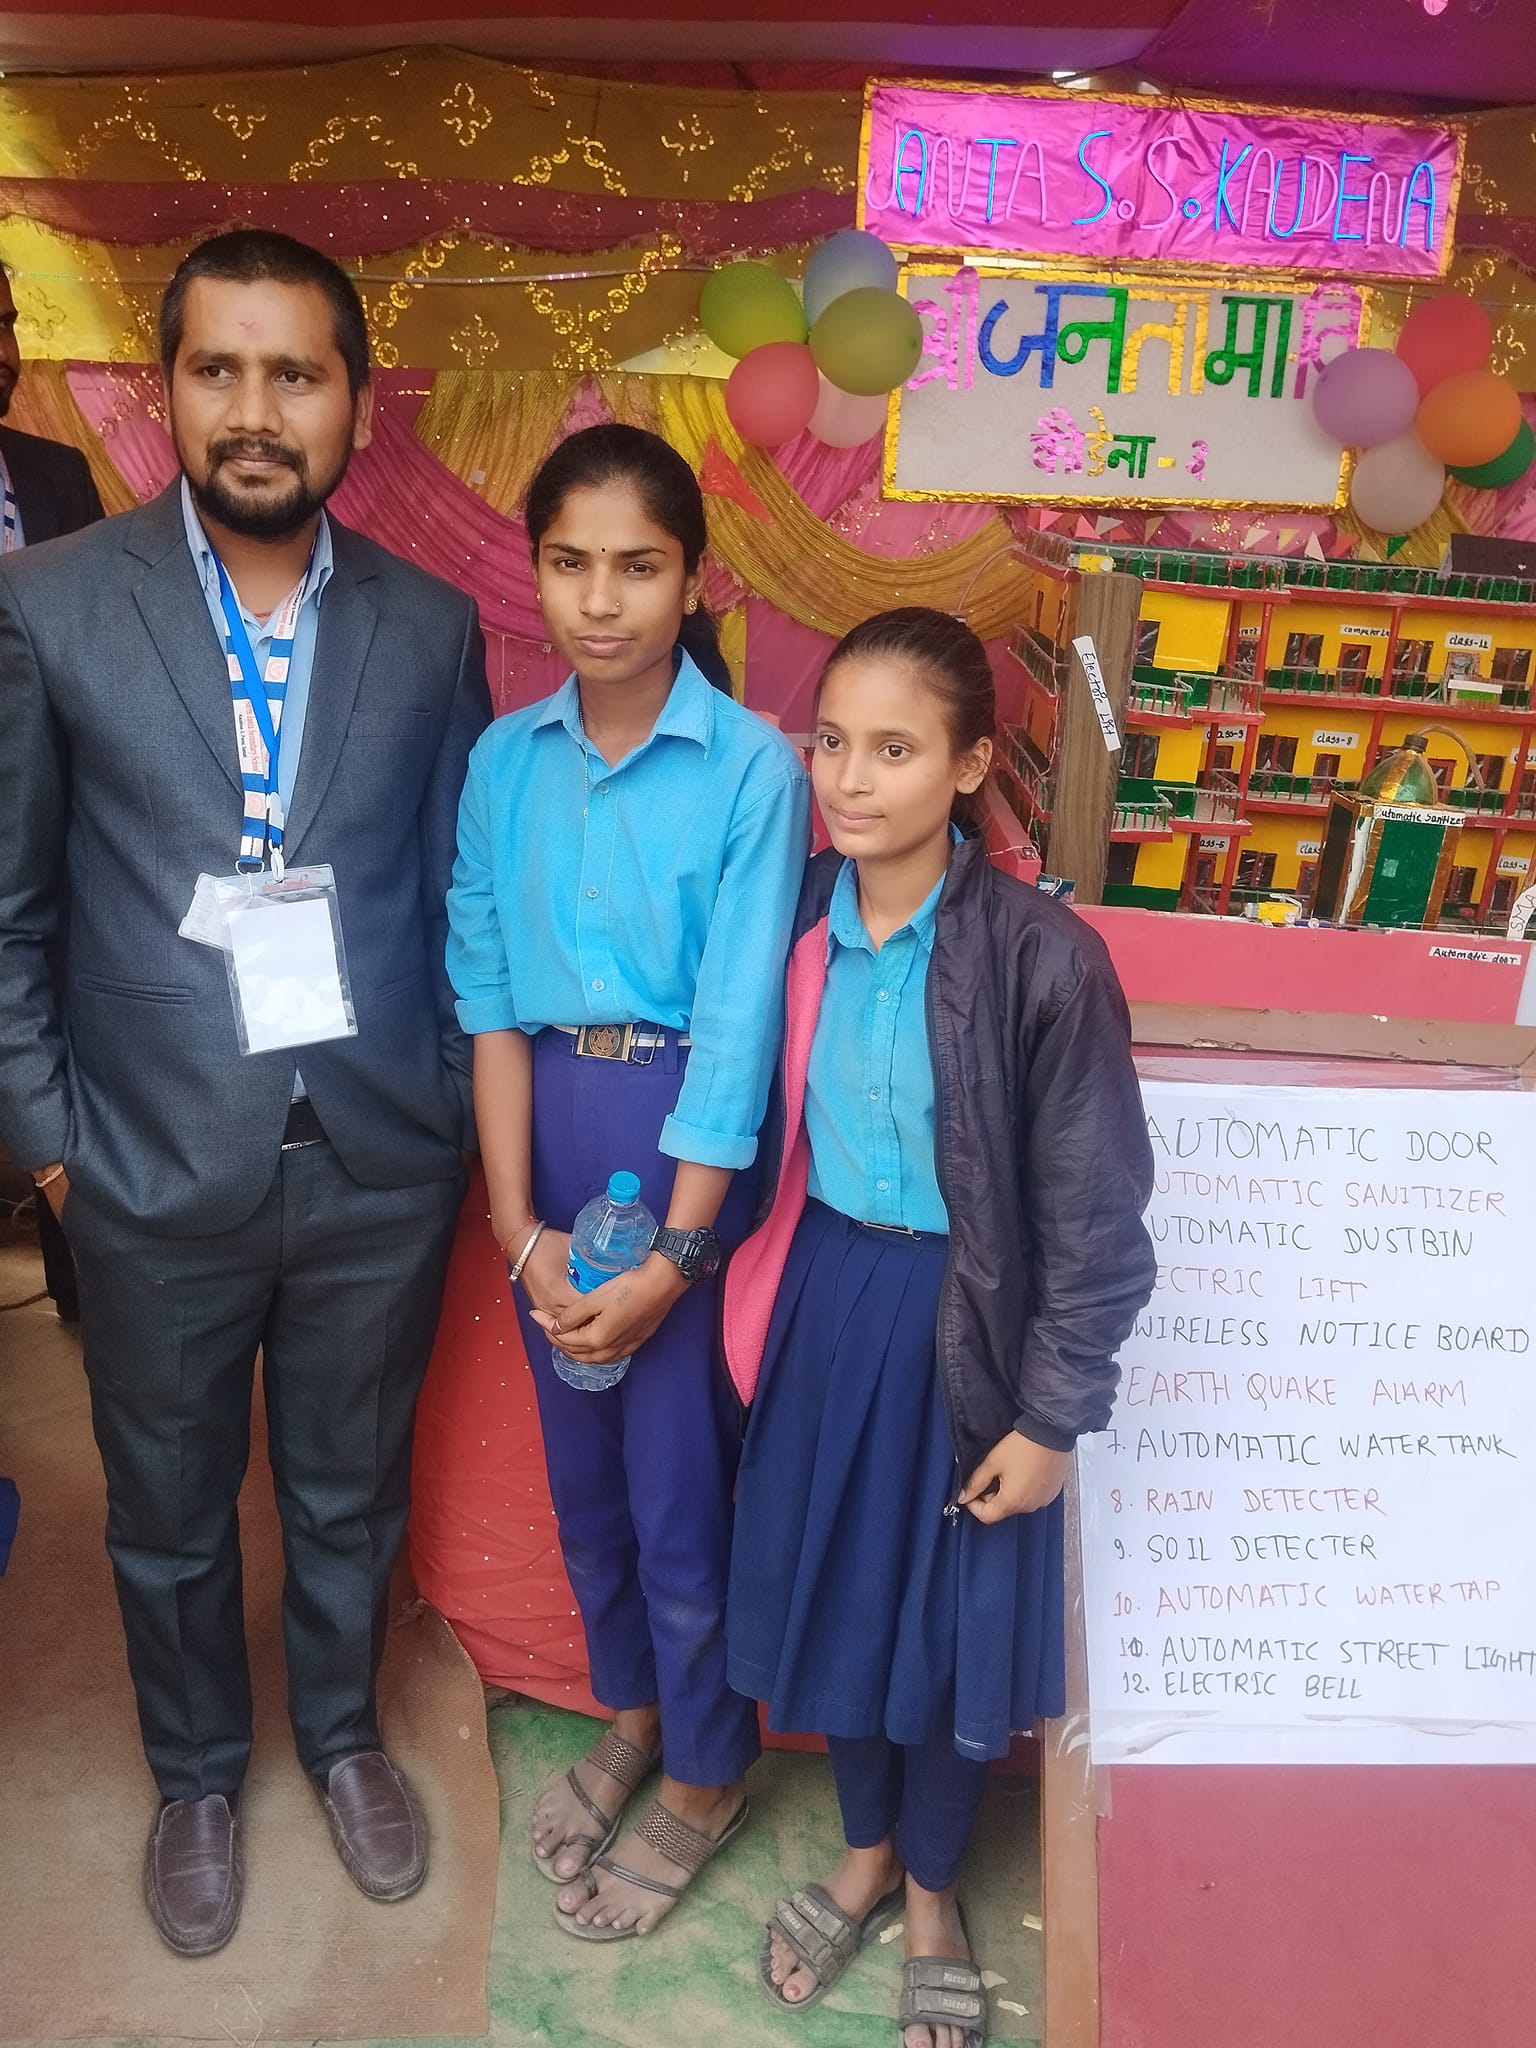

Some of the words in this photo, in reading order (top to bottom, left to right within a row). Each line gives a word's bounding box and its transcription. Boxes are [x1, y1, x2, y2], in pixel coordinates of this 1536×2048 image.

[865, 119, 1047, 224] JANTA
[1206, 729, 1244, 739] cass-9
[1316, 733, 1353, 746] class-8
[1381, 808, 1422, 823] utomatic
[1432, 947, 1487, 961] Automatic
[1492, 954, 1518, 965] door
[1148, 1115, 1378, 1163] AUTOMATIC
[1406, 1130, 1498, 1165] DOOR
[1153, 1171, 1323, 1207] UTOMATIC
[1345, 1182, 1506, 1216] SANITIZER
[1150, 1215, 1311, 1251] UTOMATIC
[1343, 1226, 1473, 1258] DUSTBIN
[1155, 1265, 1264, 1298] ECTRIC
[1299, 1276, 1368, 1303] LIFT
[1134, 1315, 1269, 1347] WIRELESS
[1299, 1319, 1421, 1350] NOTICE
[1436, 1322, 1530, 1354] BOARD
[1127, 1365, 1230, 1407] EARTH
[1246, 1372, 1337, 1411] QUAKE
[1137, 1428, 1321, 1466] AUTOMATIC
[1110, 1488, 1134, 1514] 8.
[1146, 1488, 1214, 1515] RAIN
[1243, 1487, 1387, 1516] DETECTER
[1113, 1537, 1133, 1560] 9.
[1147, 1534, 1213, 1563] SOIL
[1230, 1533, 1378, 1562] DETECTER
[1156, 1582, 1328, 1618] AUTOMATIC
[1161, 1635, 1319, 1667] AUTOMATIC
[1339, 1639, 1450, 1670] STREET
[1123, 1671, 1150, 1694] 12.
[1164, 1671, 1278, 1696] ELECTRIC
[1305, 1675, 1363, 1700] BELL
